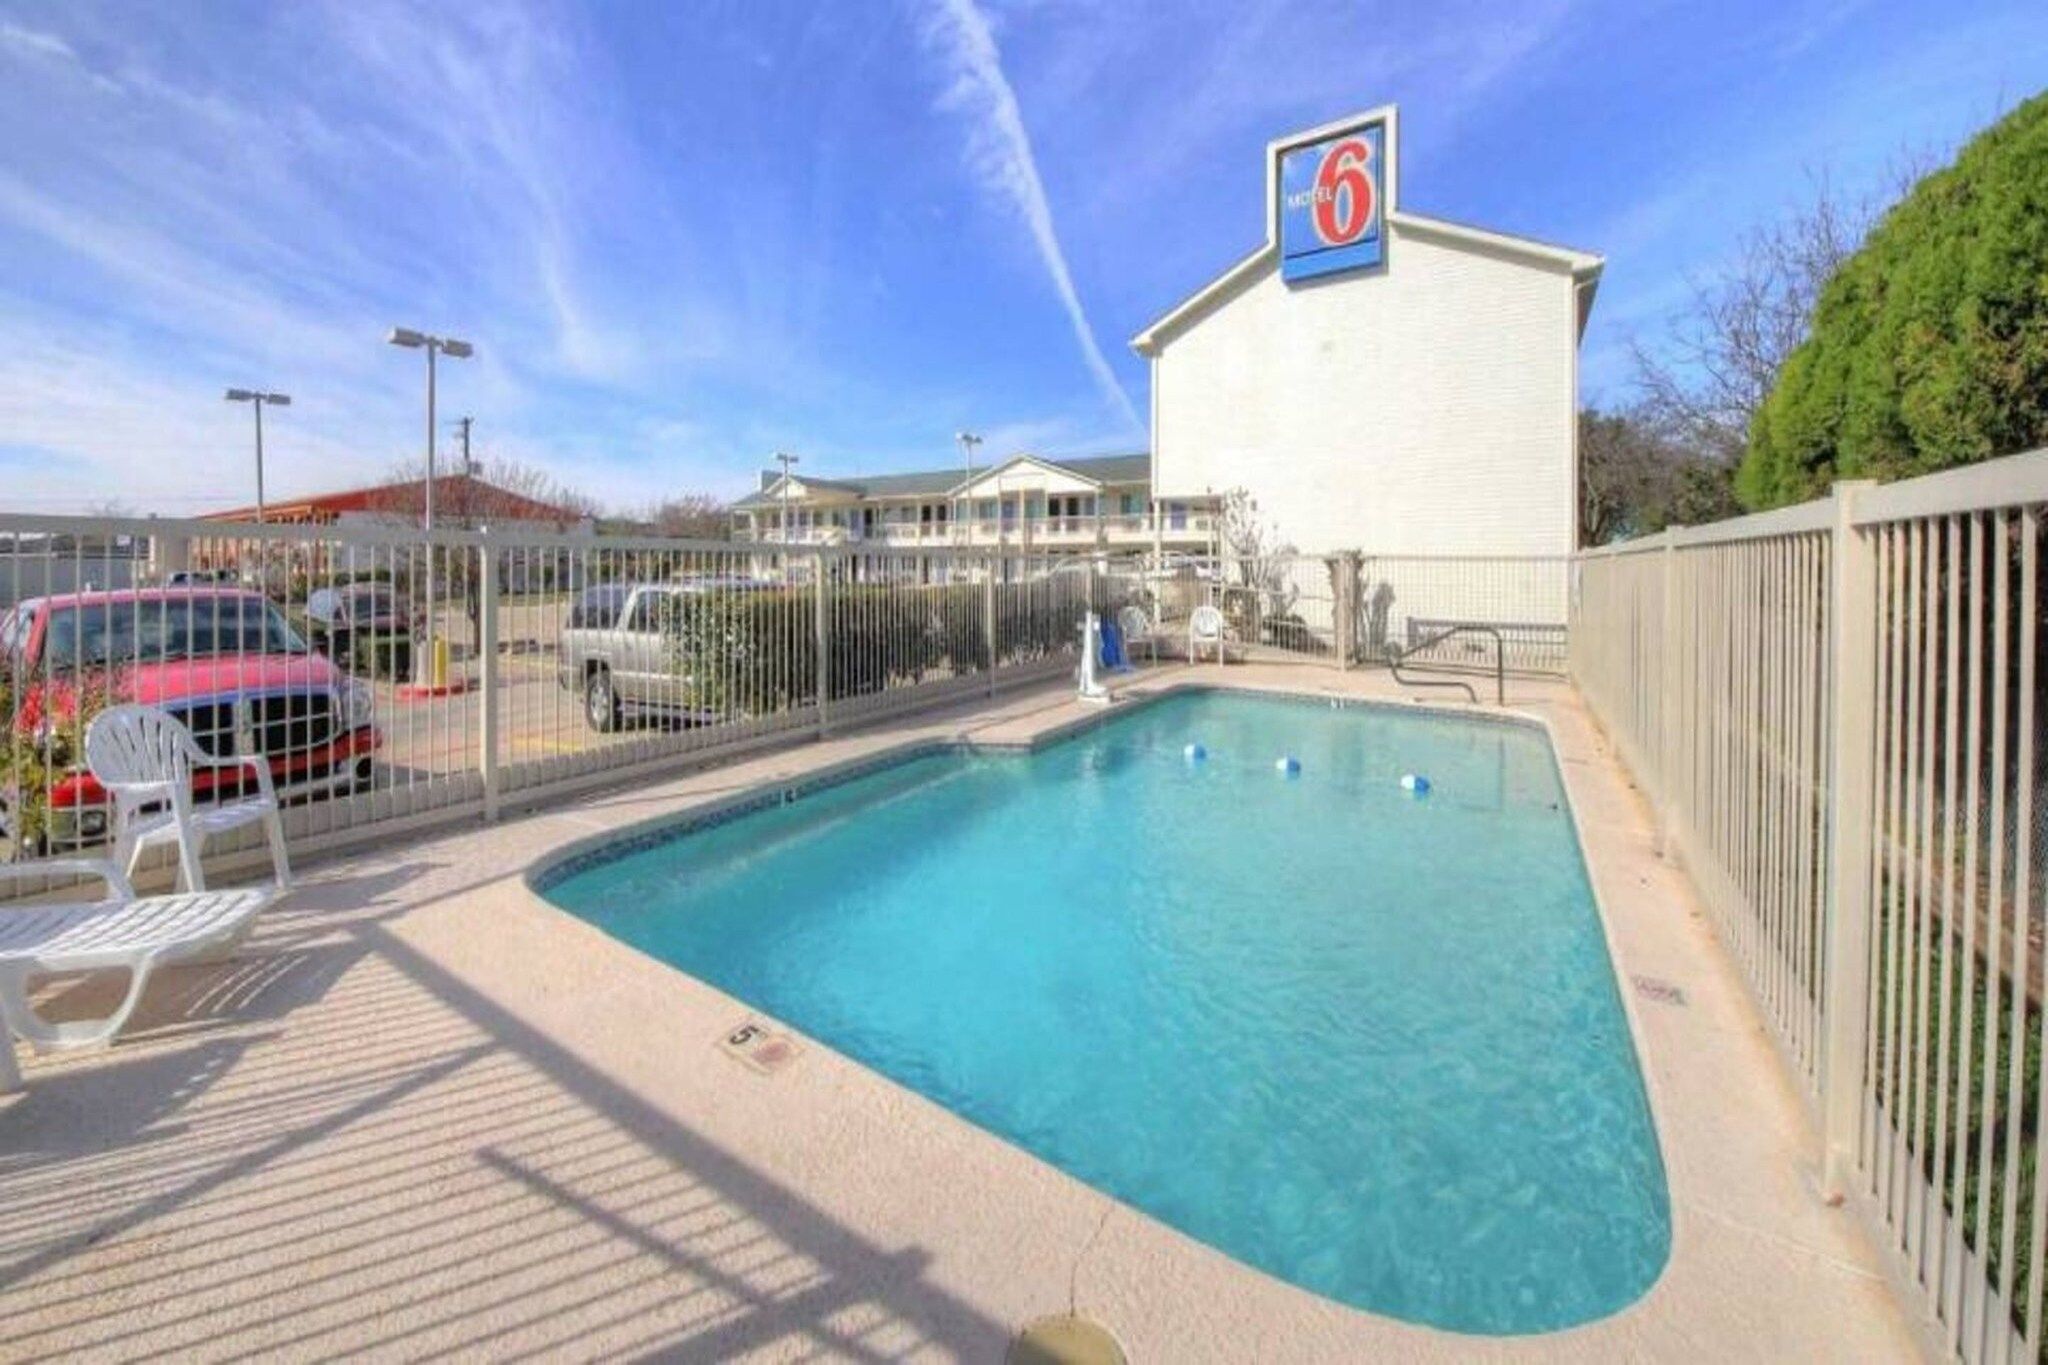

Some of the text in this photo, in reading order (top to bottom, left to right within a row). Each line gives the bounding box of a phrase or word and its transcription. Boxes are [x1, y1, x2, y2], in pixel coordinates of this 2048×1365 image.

[1288, 138, 1376, 245] MOTEL 6
[729, 1025, 760, 1045] 5
